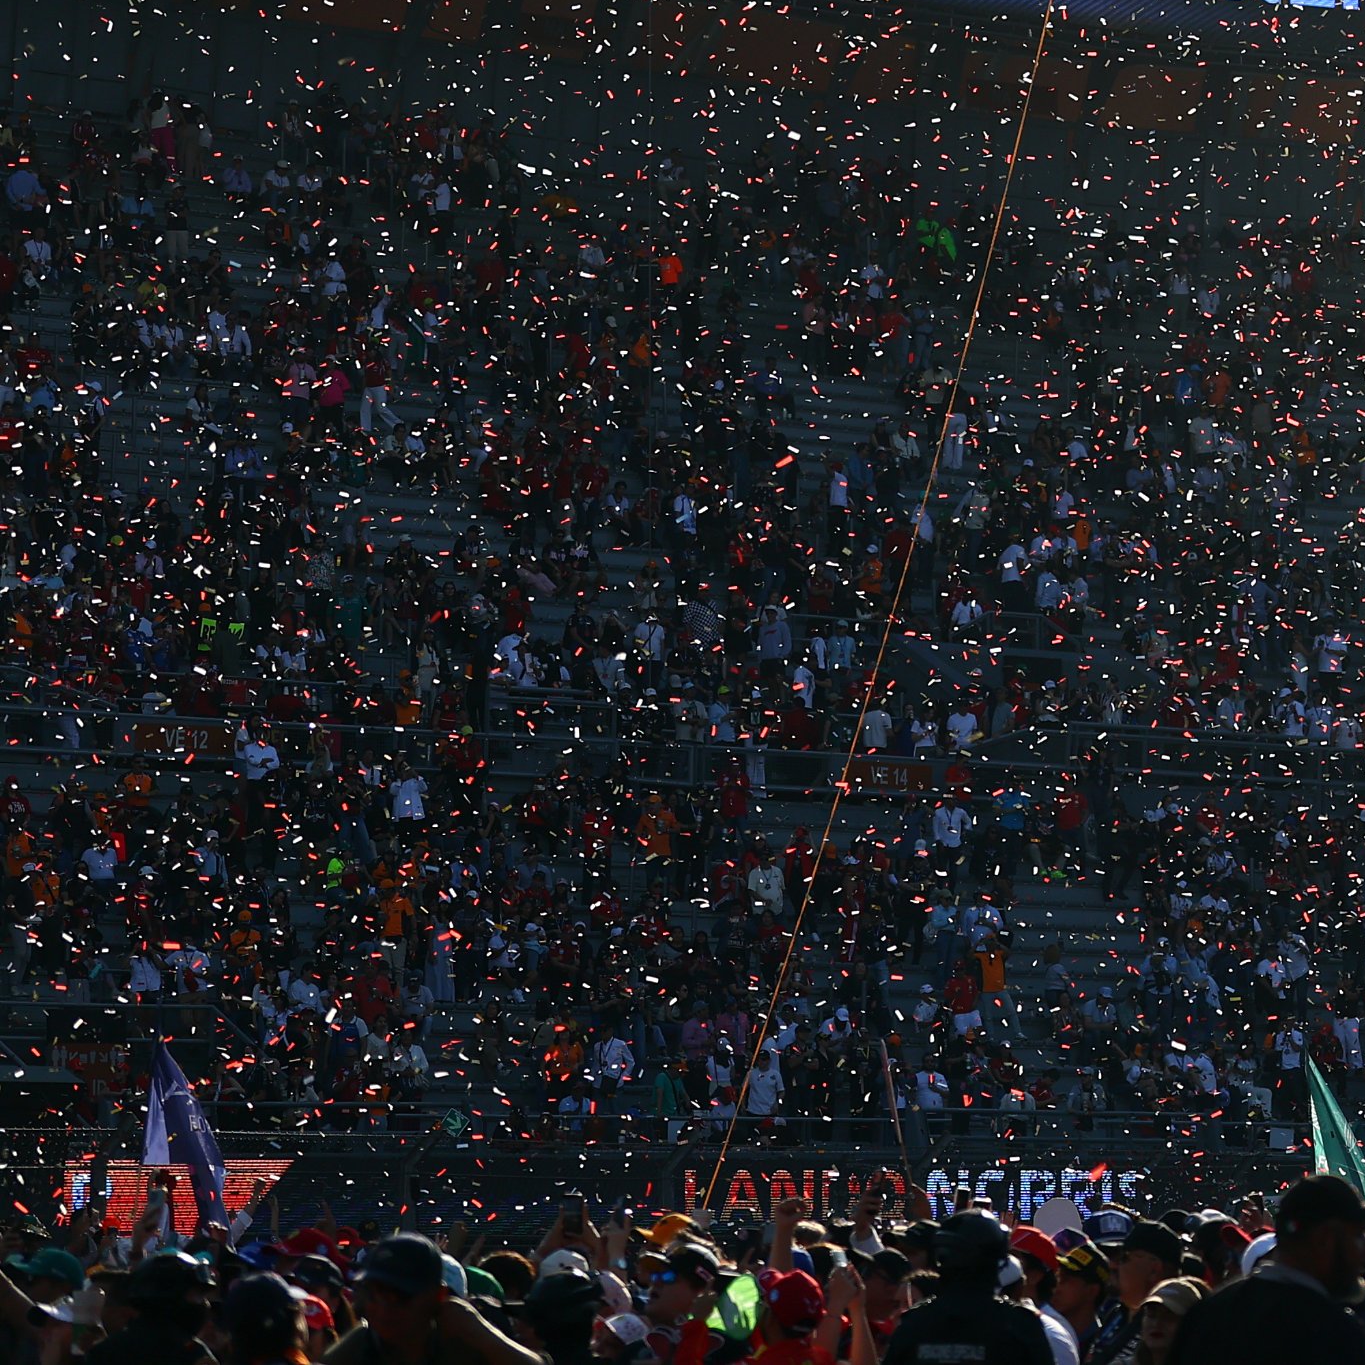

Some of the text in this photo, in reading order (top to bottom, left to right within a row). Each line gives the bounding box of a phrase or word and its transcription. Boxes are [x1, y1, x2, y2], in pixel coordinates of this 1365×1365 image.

[165, 729, 208, 750] VE 12
[870, 765, 908, 786] VE 14
